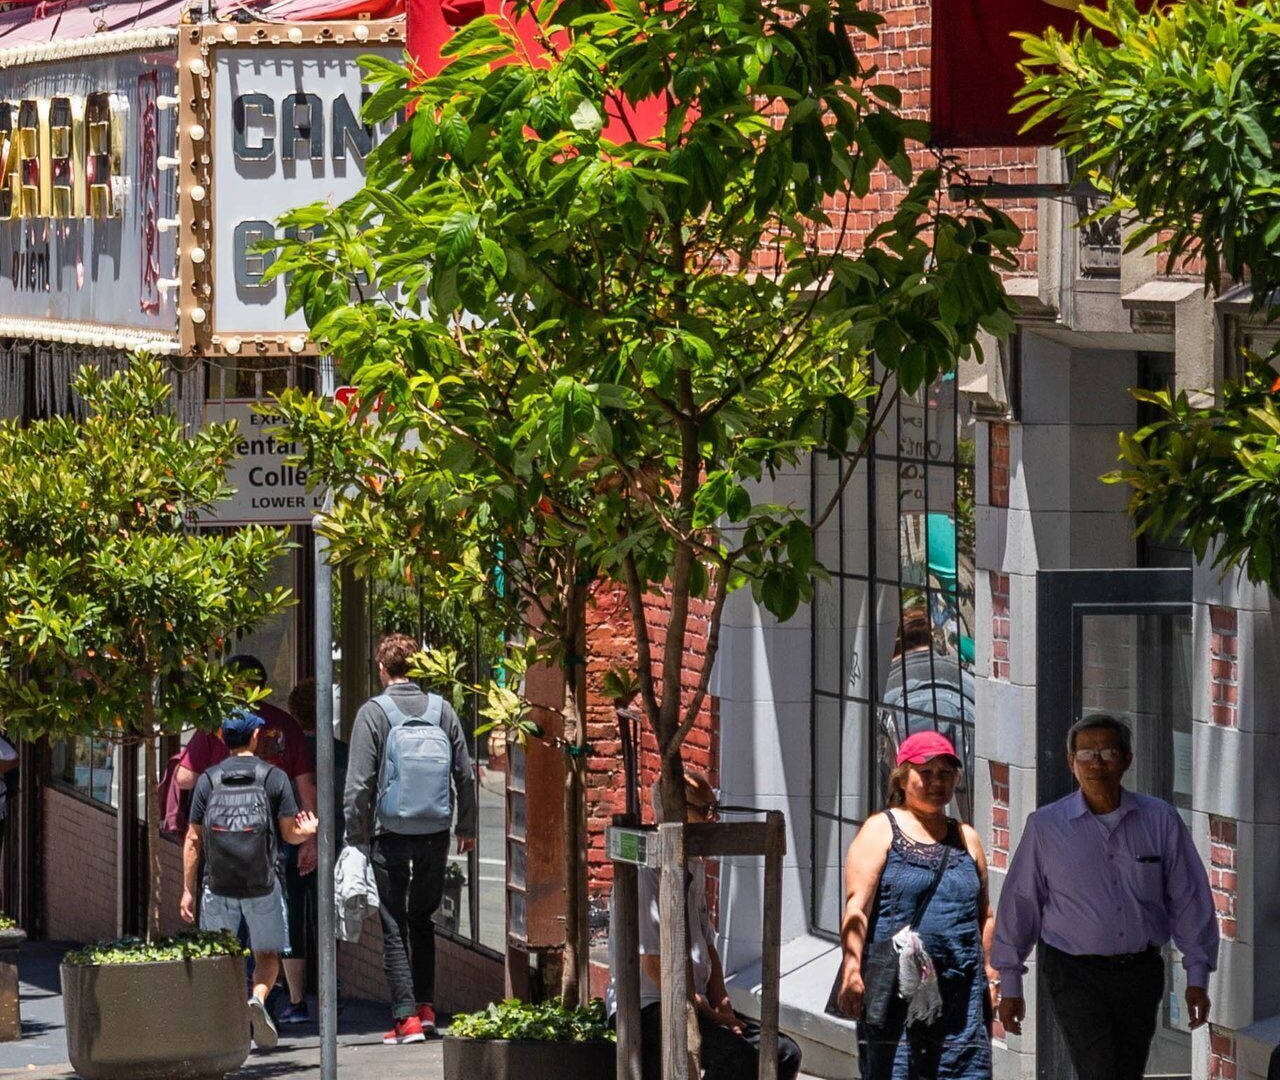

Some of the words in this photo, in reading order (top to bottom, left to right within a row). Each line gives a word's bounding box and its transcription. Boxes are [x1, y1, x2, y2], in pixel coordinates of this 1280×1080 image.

[233, 93, 376, 161] CAN
[12, 237, 51, 294] orient
[251, 497, 306, 509] LOWER
